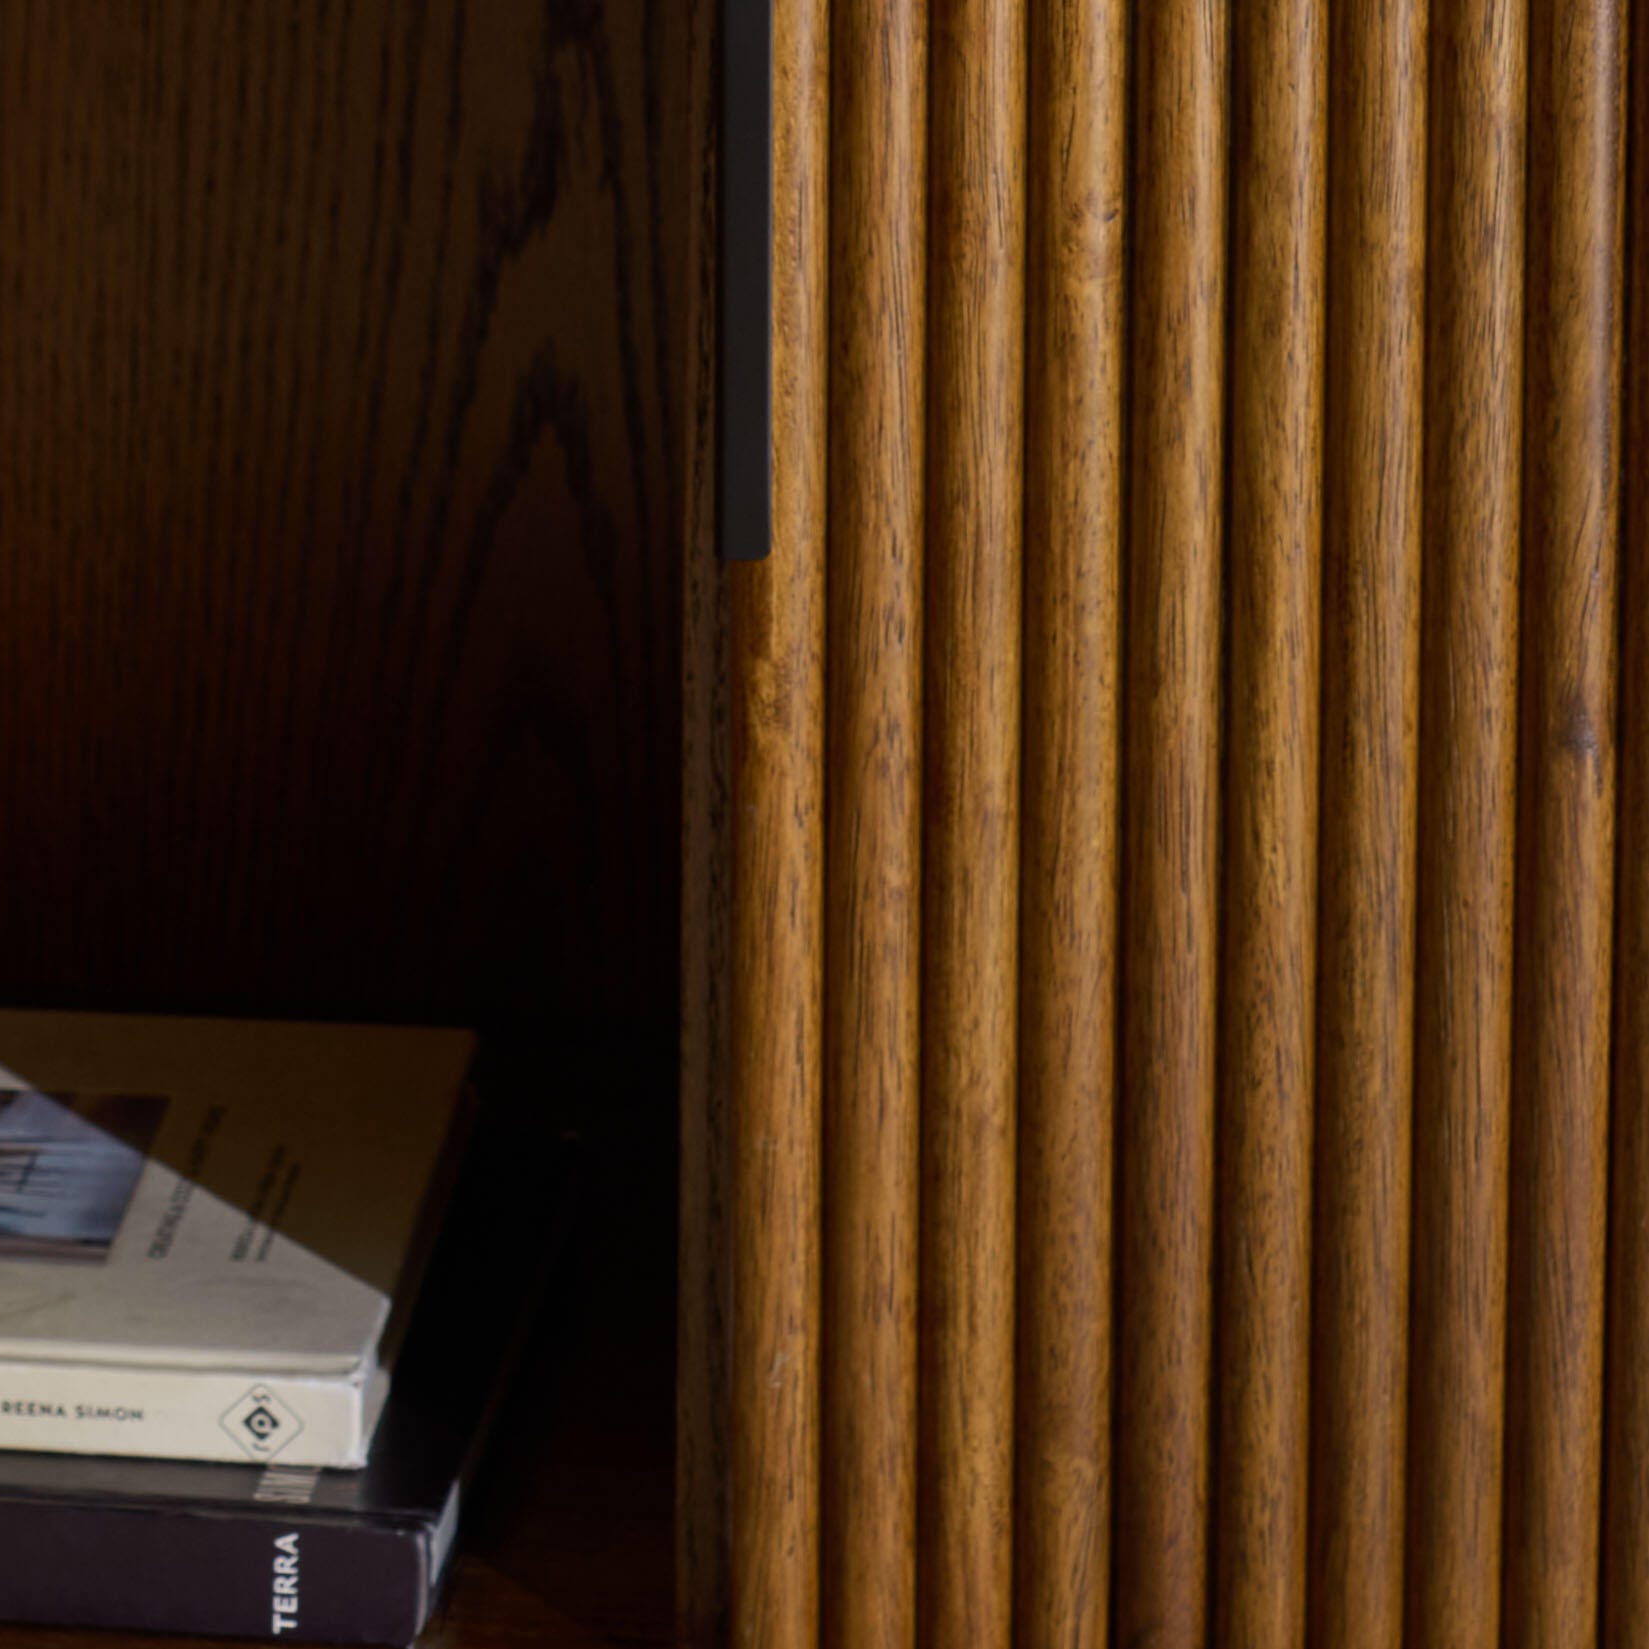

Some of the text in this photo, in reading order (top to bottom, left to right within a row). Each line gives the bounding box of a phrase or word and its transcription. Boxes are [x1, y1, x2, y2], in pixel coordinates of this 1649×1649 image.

[1, 1400, 67, 1419] REENA
[74, 1403, 145, 1422] SIMON
[272, 1532, 300, 1636] TERRA
